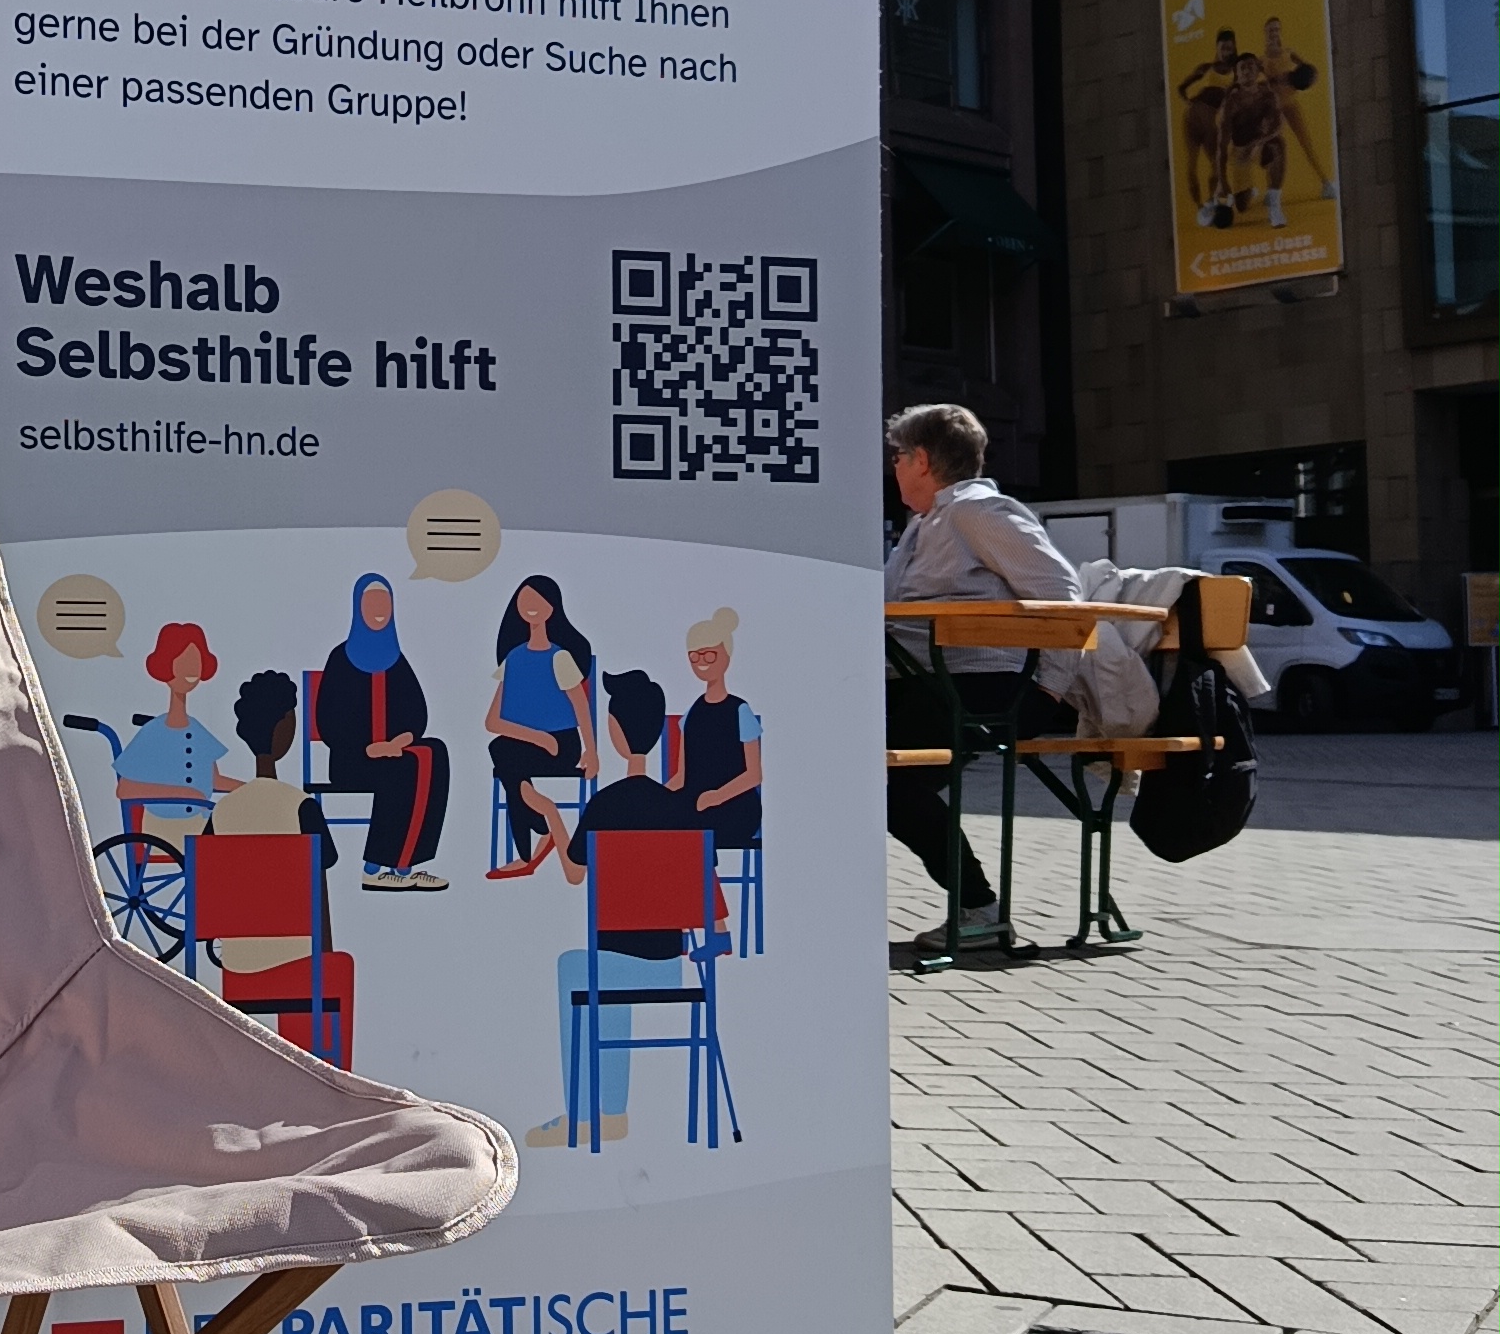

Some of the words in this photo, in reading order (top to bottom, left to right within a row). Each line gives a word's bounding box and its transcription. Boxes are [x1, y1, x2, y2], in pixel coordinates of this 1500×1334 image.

[15, 13, 119, 44] gerne
[134, 13, 187, 47] bei
[202, 19, 260, 51] der
[273, 24, 443, 71] Gründung
[458, 38, 534, 69] oder
[546, 42, 646, 77] Suche
[660, 53, 736, 83] nach
[15, 63, 109, 98] einer
[123, 77, 313, 112] passenden
[328, 84, 466, 125] Gruppe!
[15, 254, 279, 313] Weshalb
[17, 327, 352, 387] Selbsthilfe
[376, 336, 496, 391] hilft
[20, 419, 319, 457] selbsthilfe-hn.de
